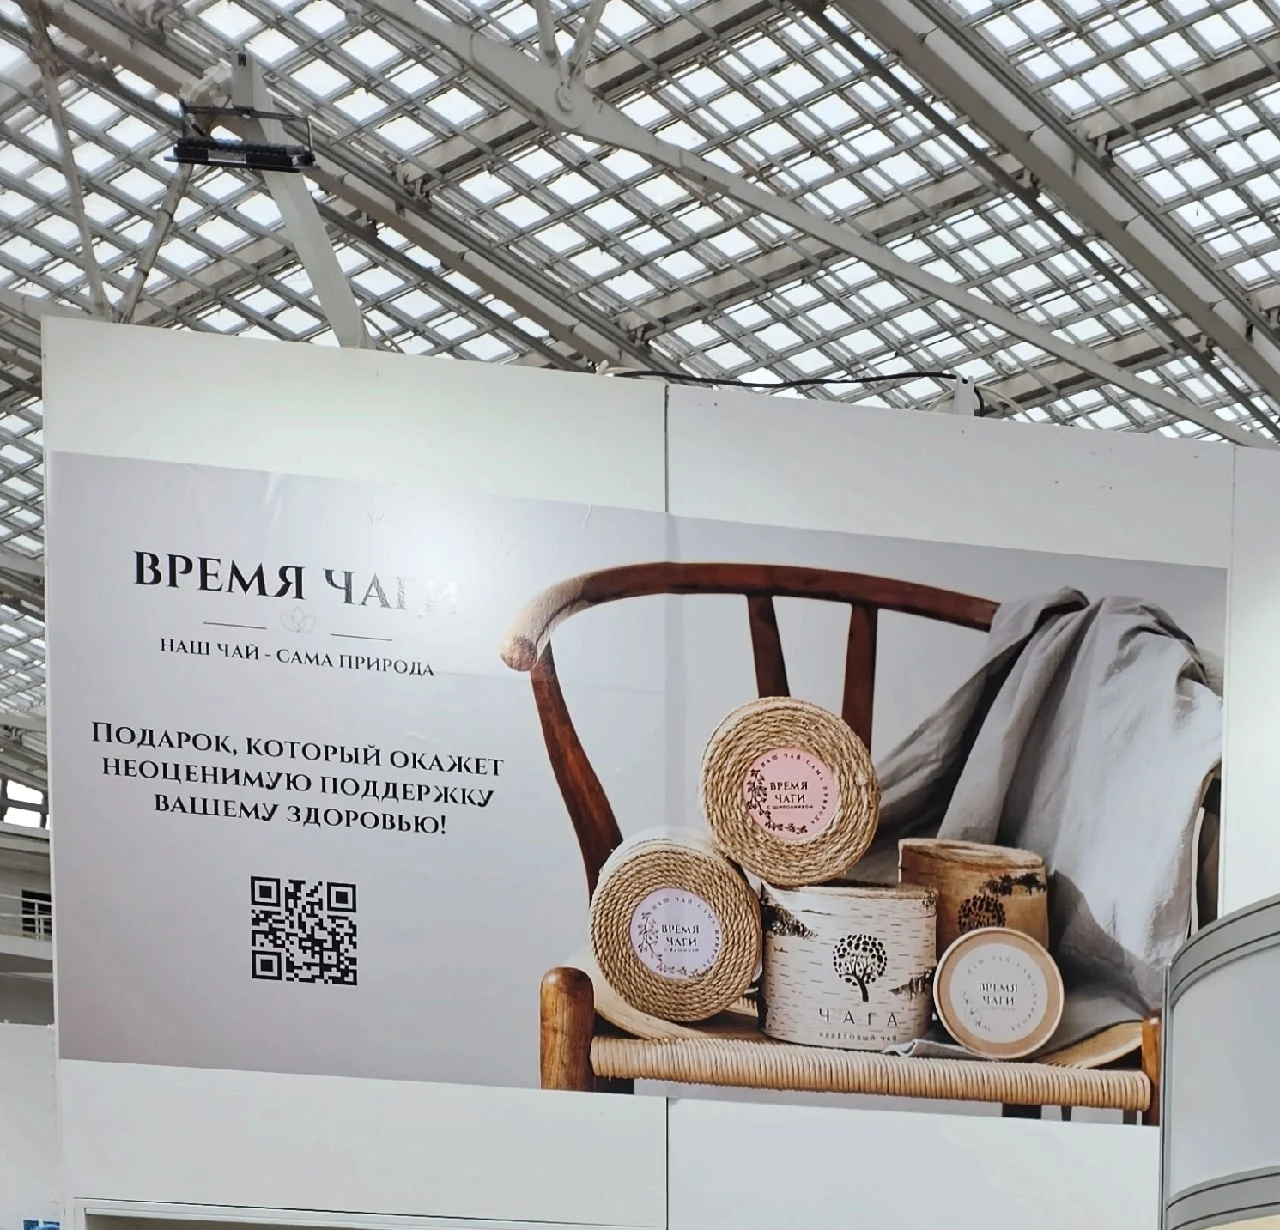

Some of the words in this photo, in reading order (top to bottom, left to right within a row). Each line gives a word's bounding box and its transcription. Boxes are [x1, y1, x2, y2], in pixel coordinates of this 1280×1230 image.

[134, 551, 306, 600] ВРЕМЯ
[324, 568, 458, 616] ЧАГ
[160, 638, 210, 656] НАШ
[217, 642, 259, 660] ЧАЙ
[277, 649, 333, 668] САМА
[340, 654, 435, 677] ПРИРОДА
[92, 721, 238, 756] ПОДАРОК,
[245, 737, 381, 767] КОТОРЫЙ
[390, 751, 504, 776] ОКАЖЕТ
[102, 757, 311, 791] НЕОЦЕНИМУЮ
[320, 775, 494, 808] ПОДДЕРЖКУ
[770, 781, 808, 790] ВРЕМЯ
[774, 794, 805, 803] ЧАГИ
[154, 794, 278, 822] ВАШЕМУ
[287, 806, 447, 835] ЗДОРОВЬЮ!
[819, 1007, 897, 1027] ЧАГА
